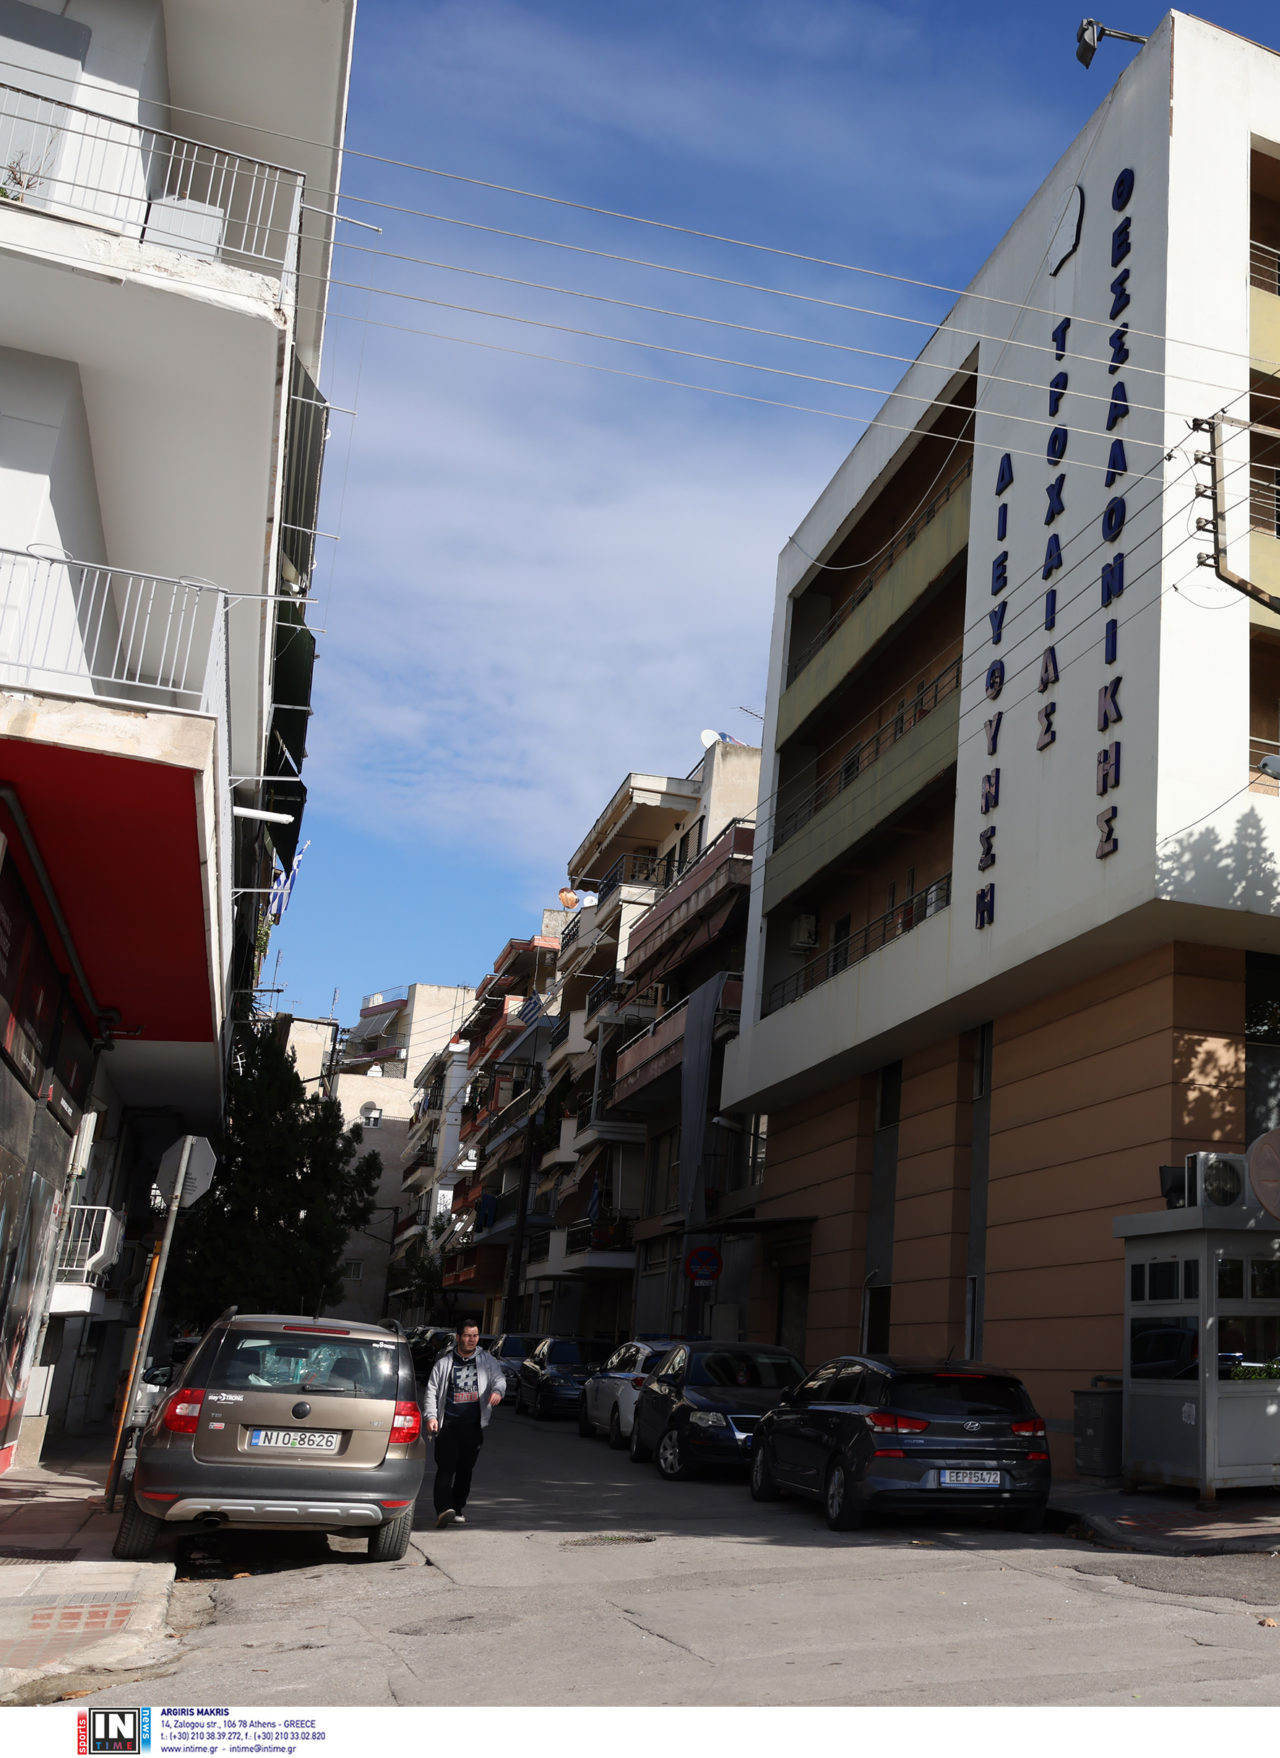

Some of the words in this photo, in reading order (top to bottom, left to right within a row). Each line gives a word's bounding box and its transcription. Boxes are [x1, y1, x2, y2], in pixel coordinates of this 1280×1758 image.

[975, 451, 1014, 931] ΔΙΕΥΘΥΝΣΗ
[1036, 315, 1071, 752] ΤΡΟΧΑΙΑΣ
[1095, 167, 1135, 860] ΘΕΣΣΑΛΟΝΙΚΗΣ
